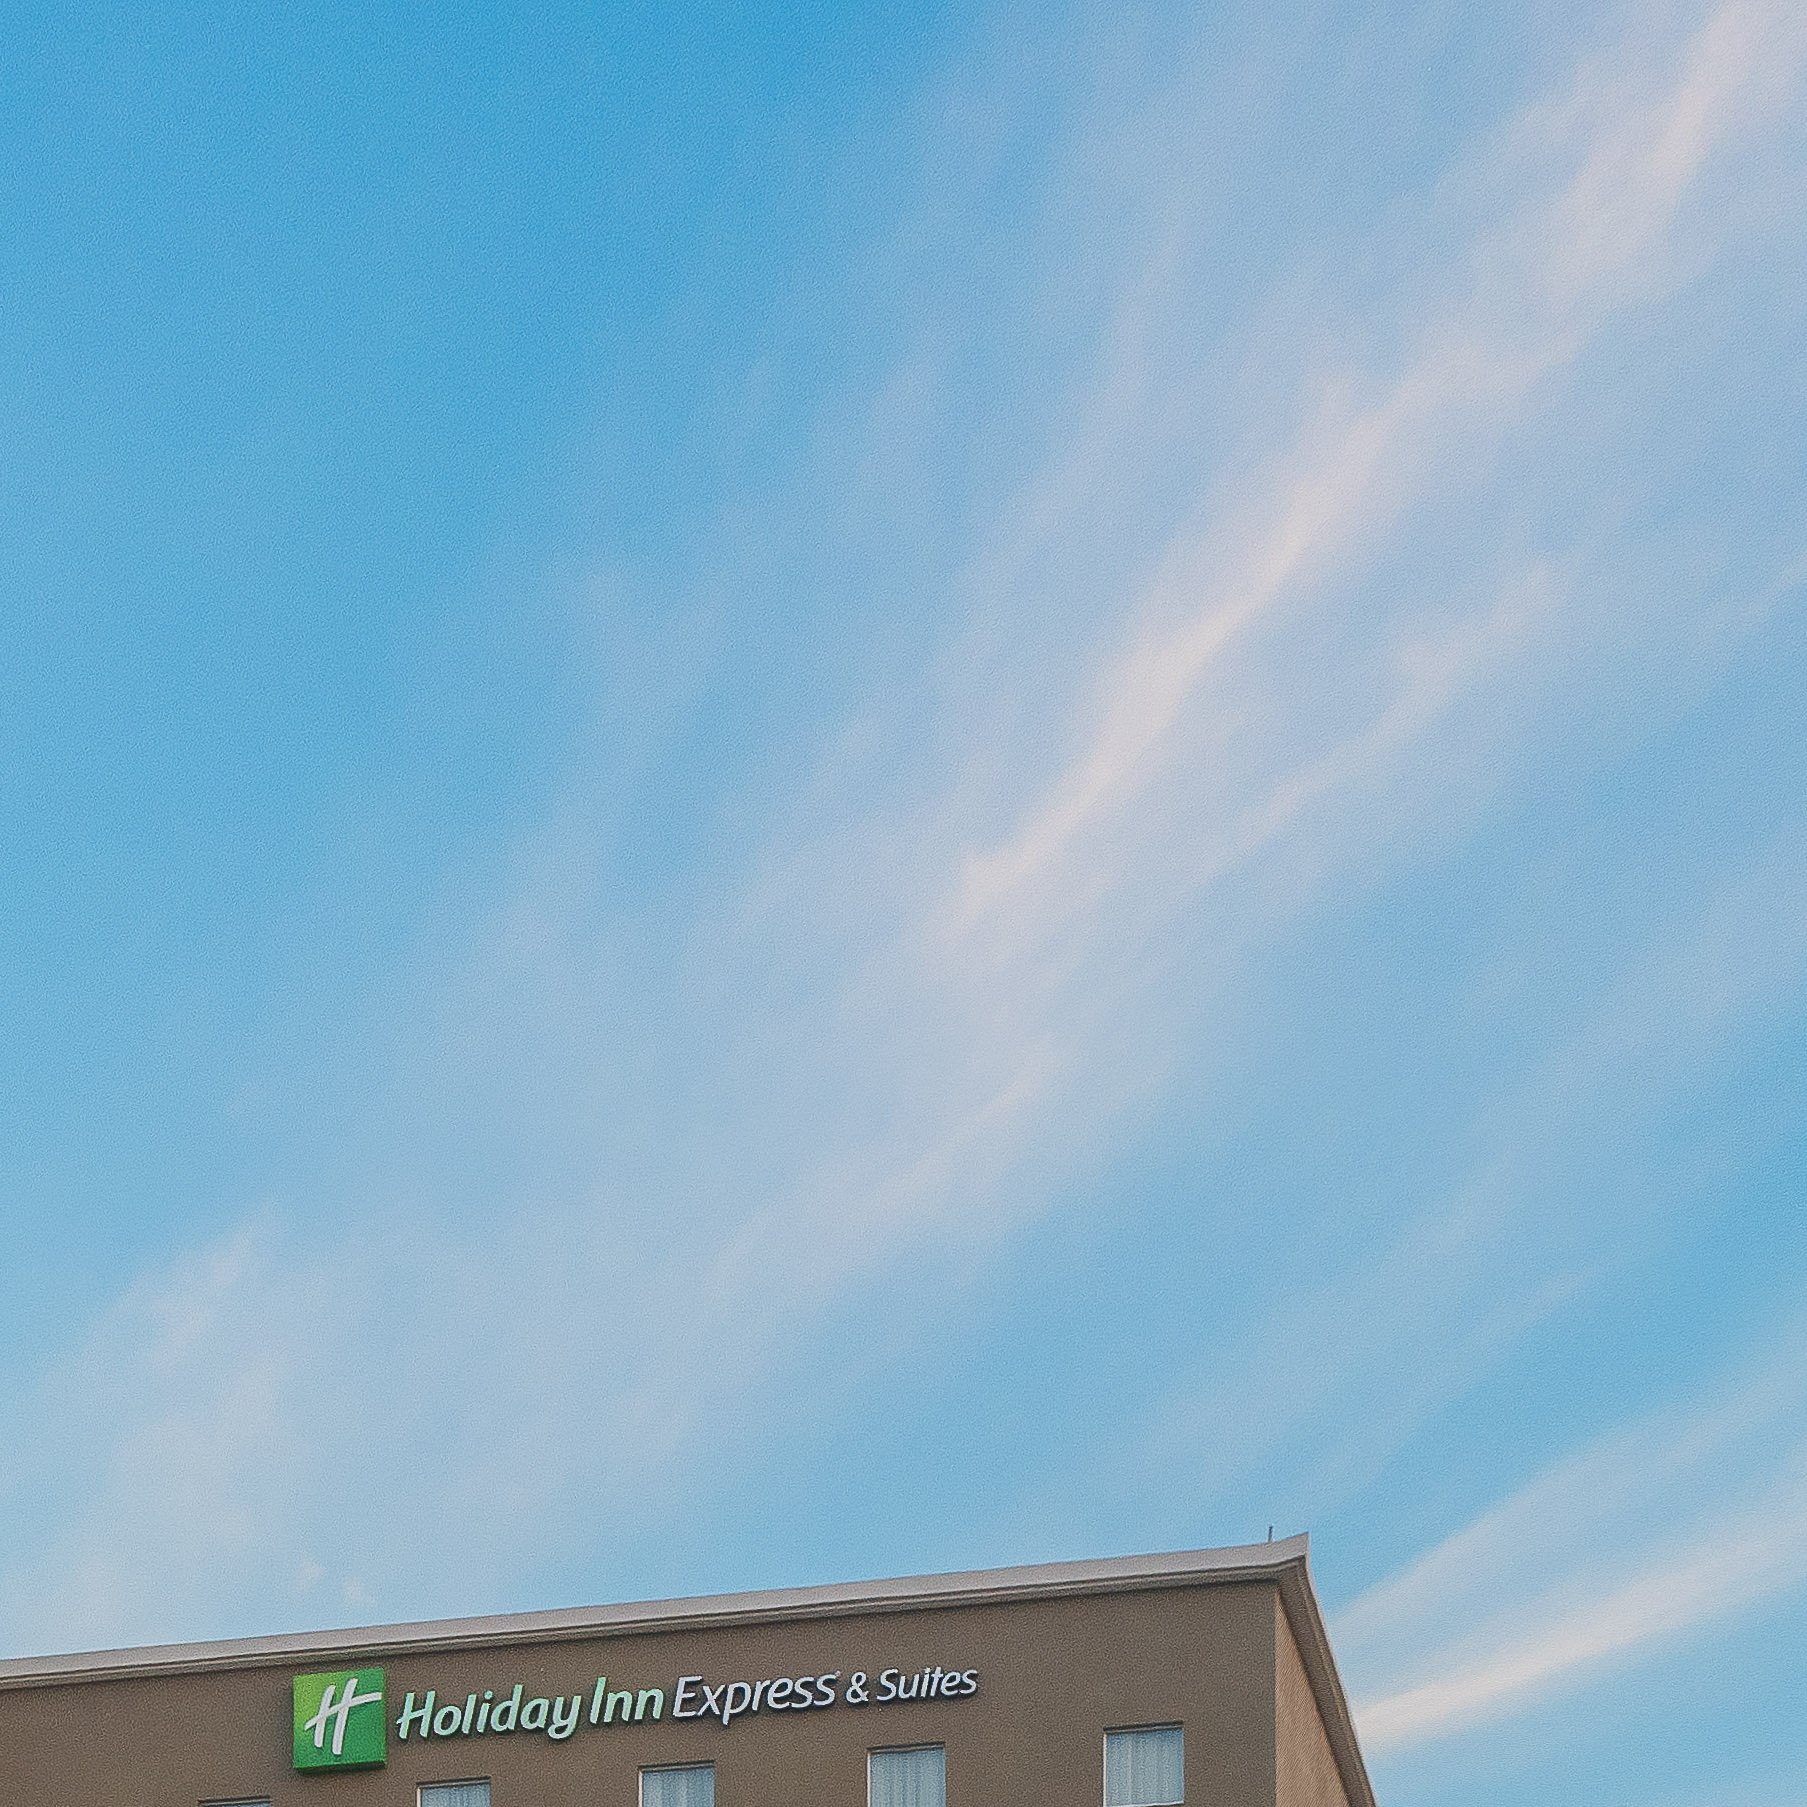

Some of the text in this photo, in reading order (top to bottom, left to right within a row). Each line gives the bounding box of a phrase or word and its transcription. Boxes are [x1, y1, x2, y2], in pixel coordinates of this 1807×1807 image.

[396, 1666, 979, 1740] Holiday Inn Express & Suites
